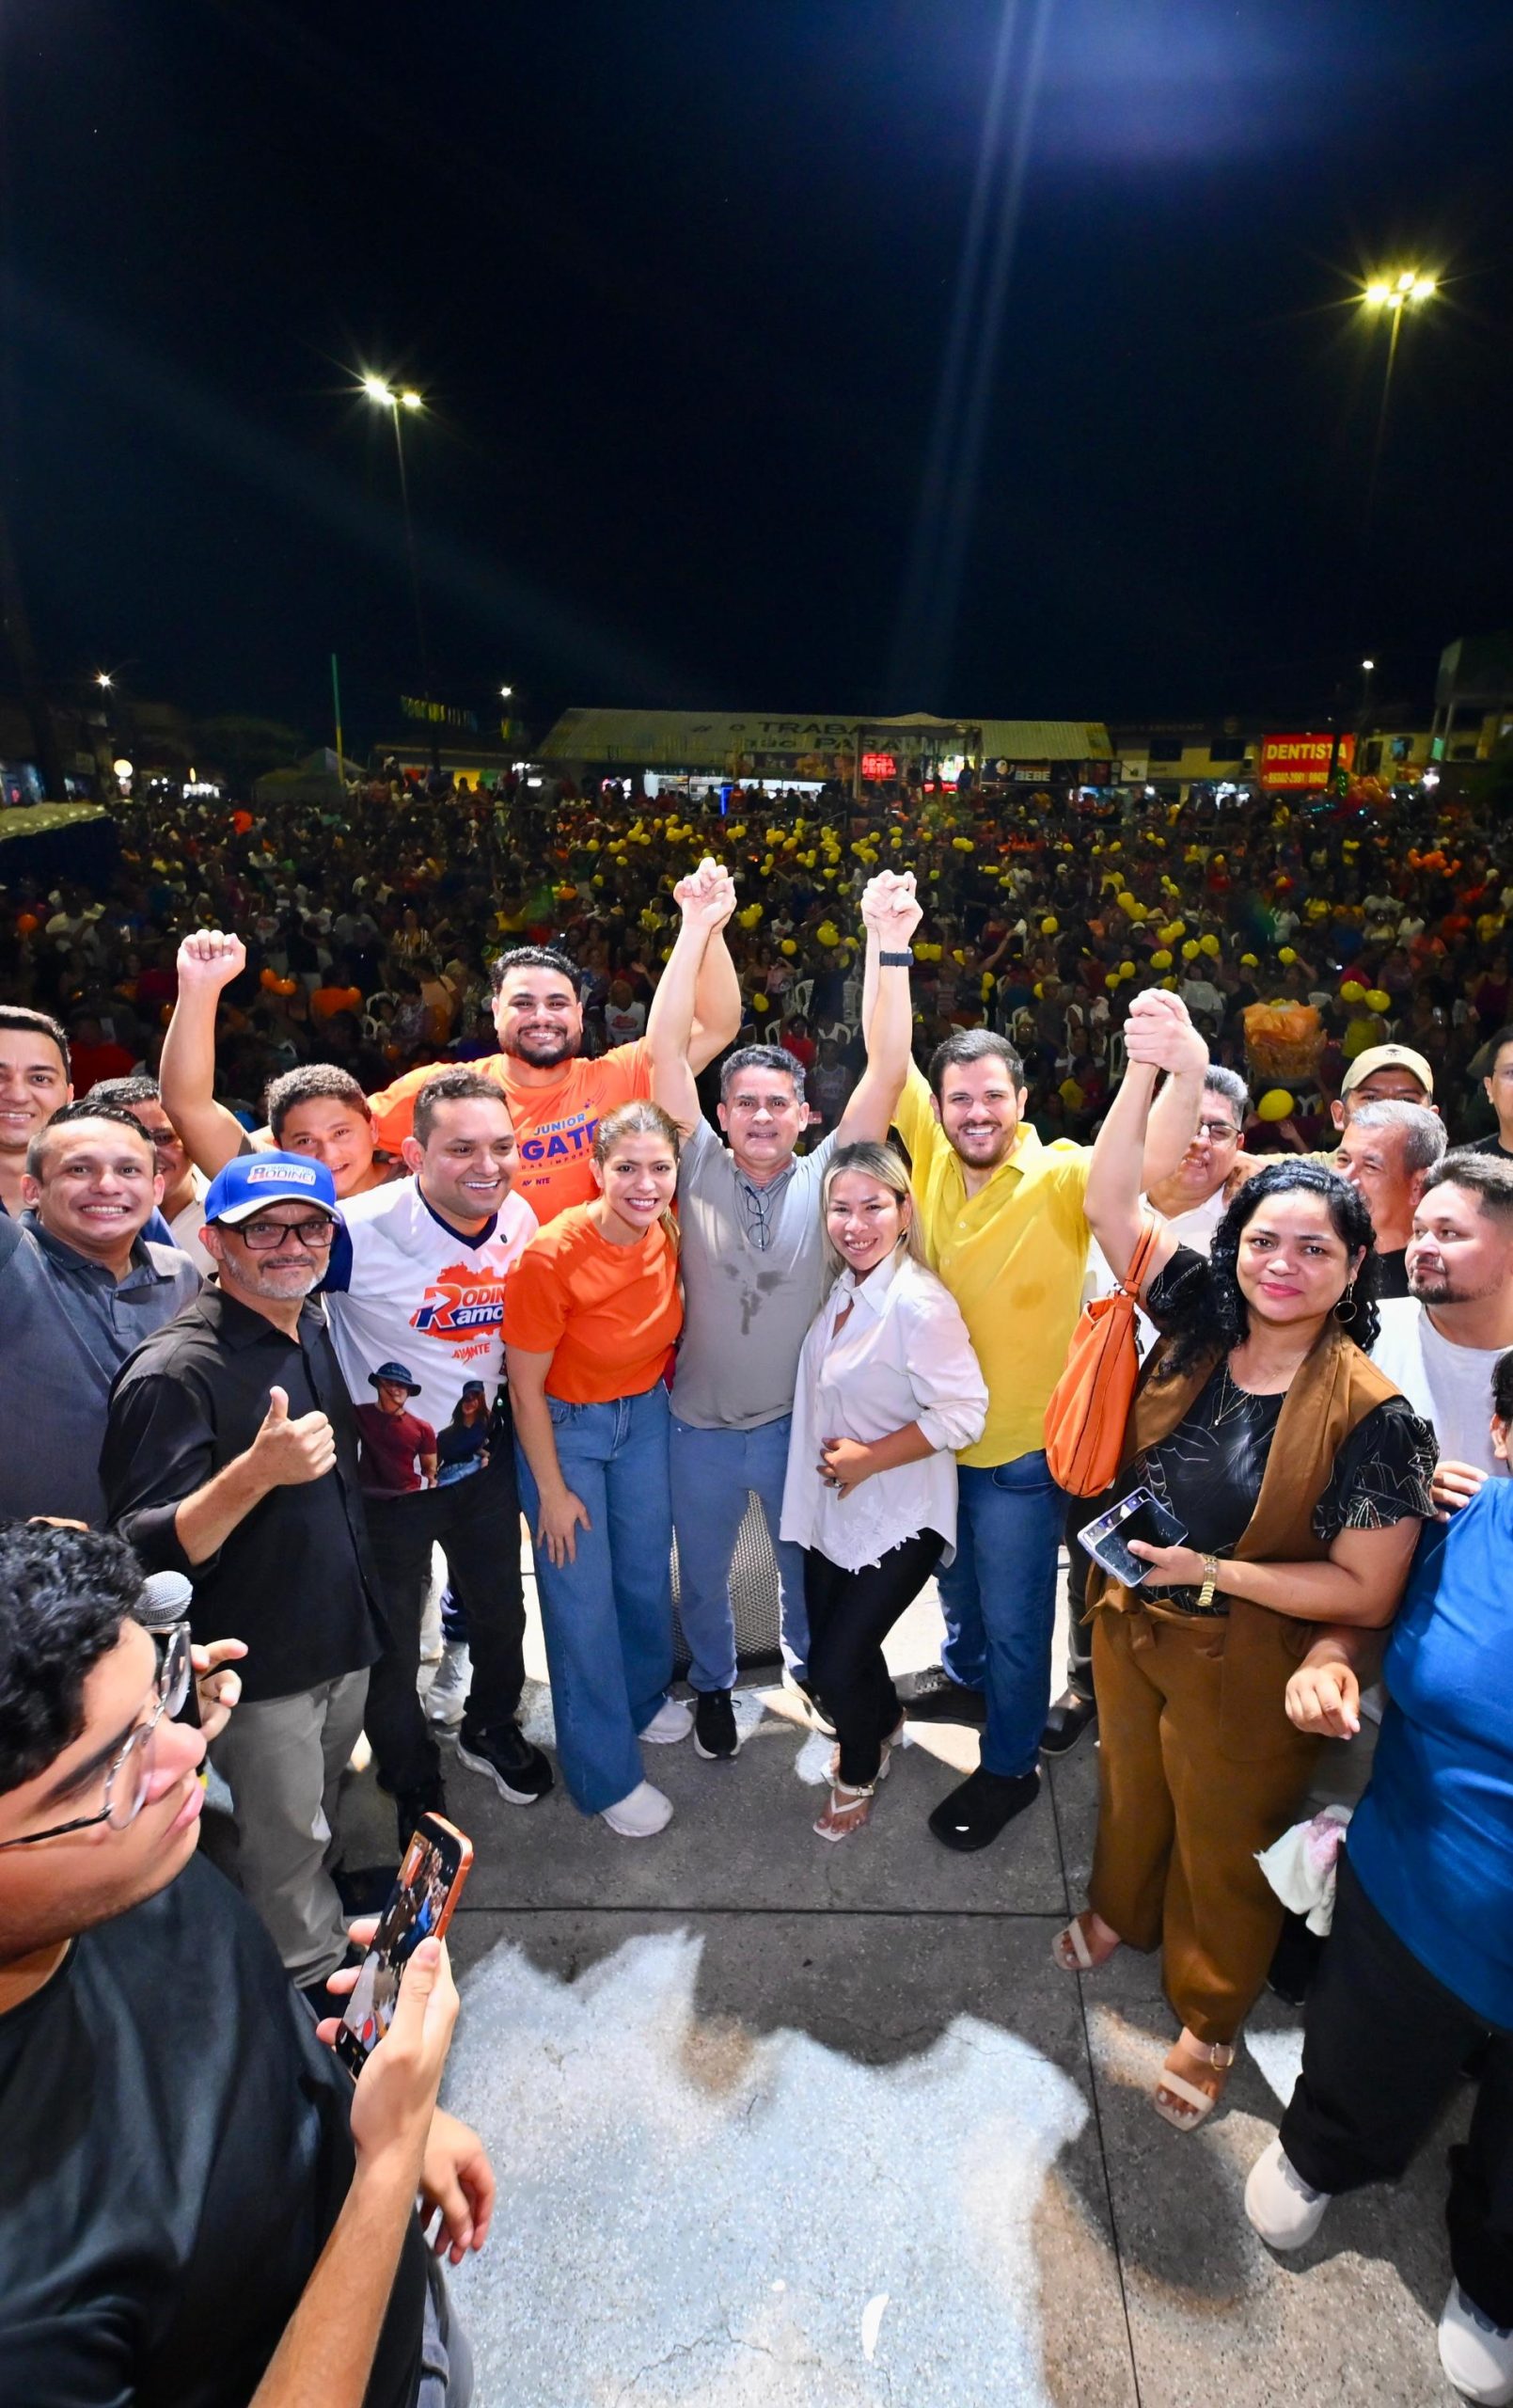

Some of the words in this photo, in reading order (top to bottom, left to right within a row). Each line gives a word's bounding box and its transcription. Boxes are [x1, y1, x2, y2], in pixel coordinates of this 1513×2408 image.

[1267, 743, 1347, 760] DENTISTA
[533, 1113, 586, 1136] JUNIOR
[516, 1117, 600, 1161] GAT
[550, 1148, 591, 1166] IMPORT
[522, 1177, 551, 1187] AVNTE
[451, 1342, 491, 1365] AVANTE
